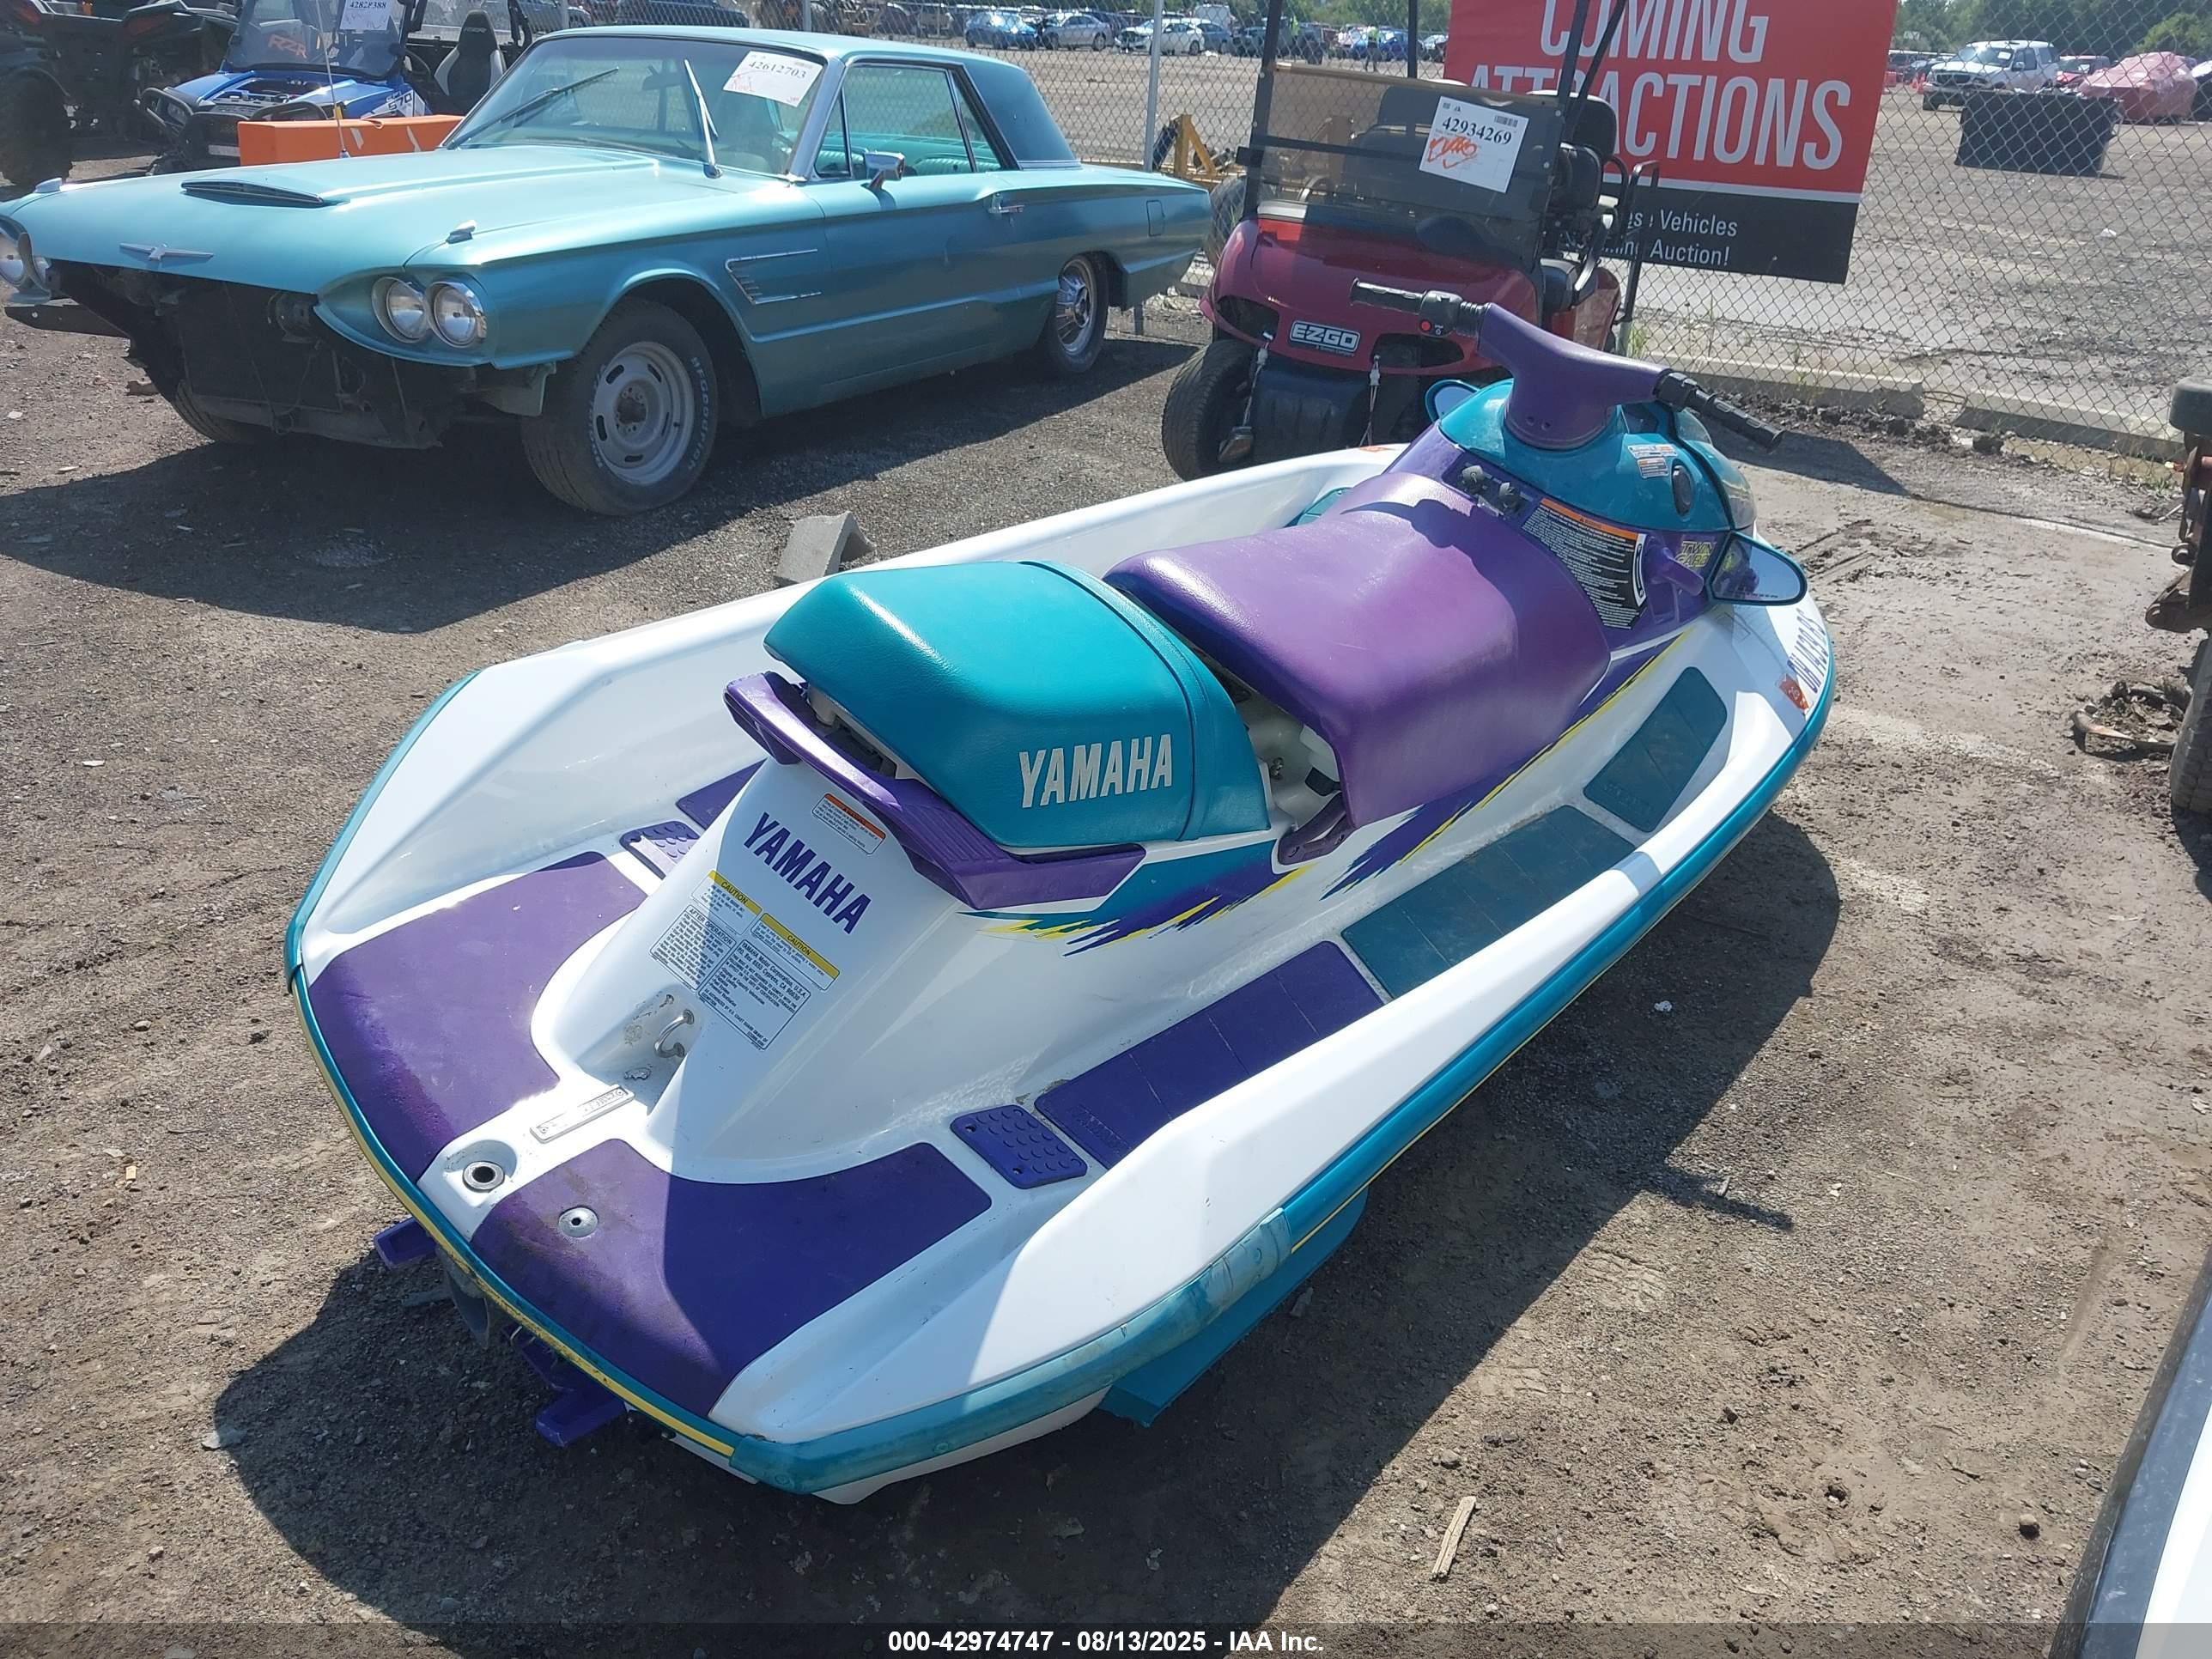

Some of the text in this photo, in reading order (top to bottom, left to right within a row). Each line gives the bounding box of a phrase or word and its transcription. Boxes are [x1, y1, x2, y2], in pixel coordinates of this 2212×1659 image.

[749, 61, 807, 79] 42612703
[388, 93, 413, 111] 570
[1471, 64, 1852, 170] ACTIONS
[1443, 117, 1512, 145] 42934269
[1660, 209, 1738, 237] Vehicles
[1650, 239, 1730, 266] Auction!
[1292, 323, 1358, 349] EZGO
[1681, 540, 1716, 556] TWIN
[1018, 733, 1172, 808] YAMAHA
[744, 811, 872, 935] YAMAHA
[720, 880, 749, 904] CAUTION
[688, 908, 733, 945] AFTER OPERATION
[786, 933, 811, 956] CAUTION
